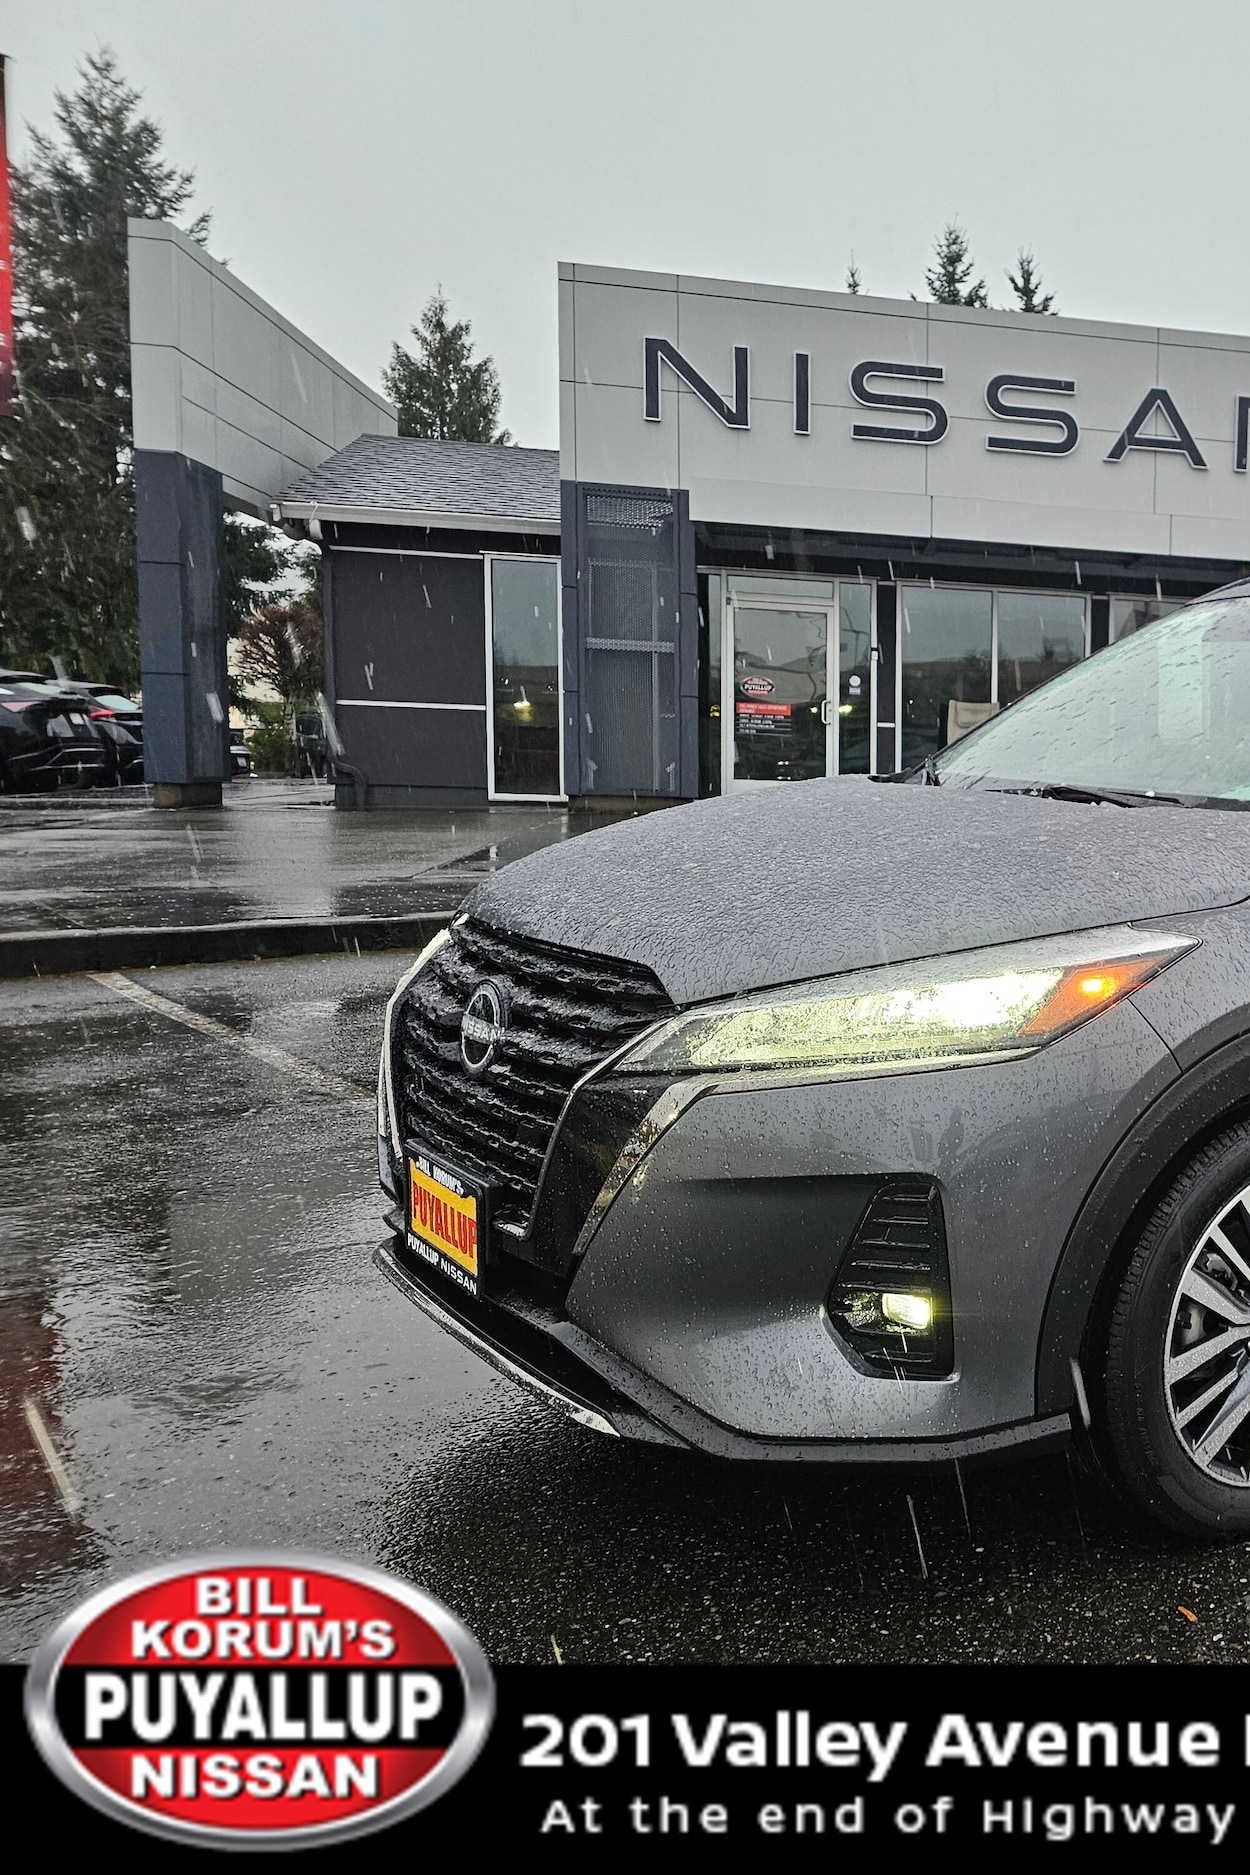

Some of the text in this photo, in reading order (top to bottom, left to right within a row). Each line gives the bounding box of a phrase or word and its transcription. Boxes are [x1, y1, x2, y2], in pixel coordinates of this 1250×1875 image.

[463, 1015, 505, 1042] SSAN
[412, 1180, 478, 1259] PUYALLUP
[407, 1232, 478, 1296] PUYALLUP NISSAN
